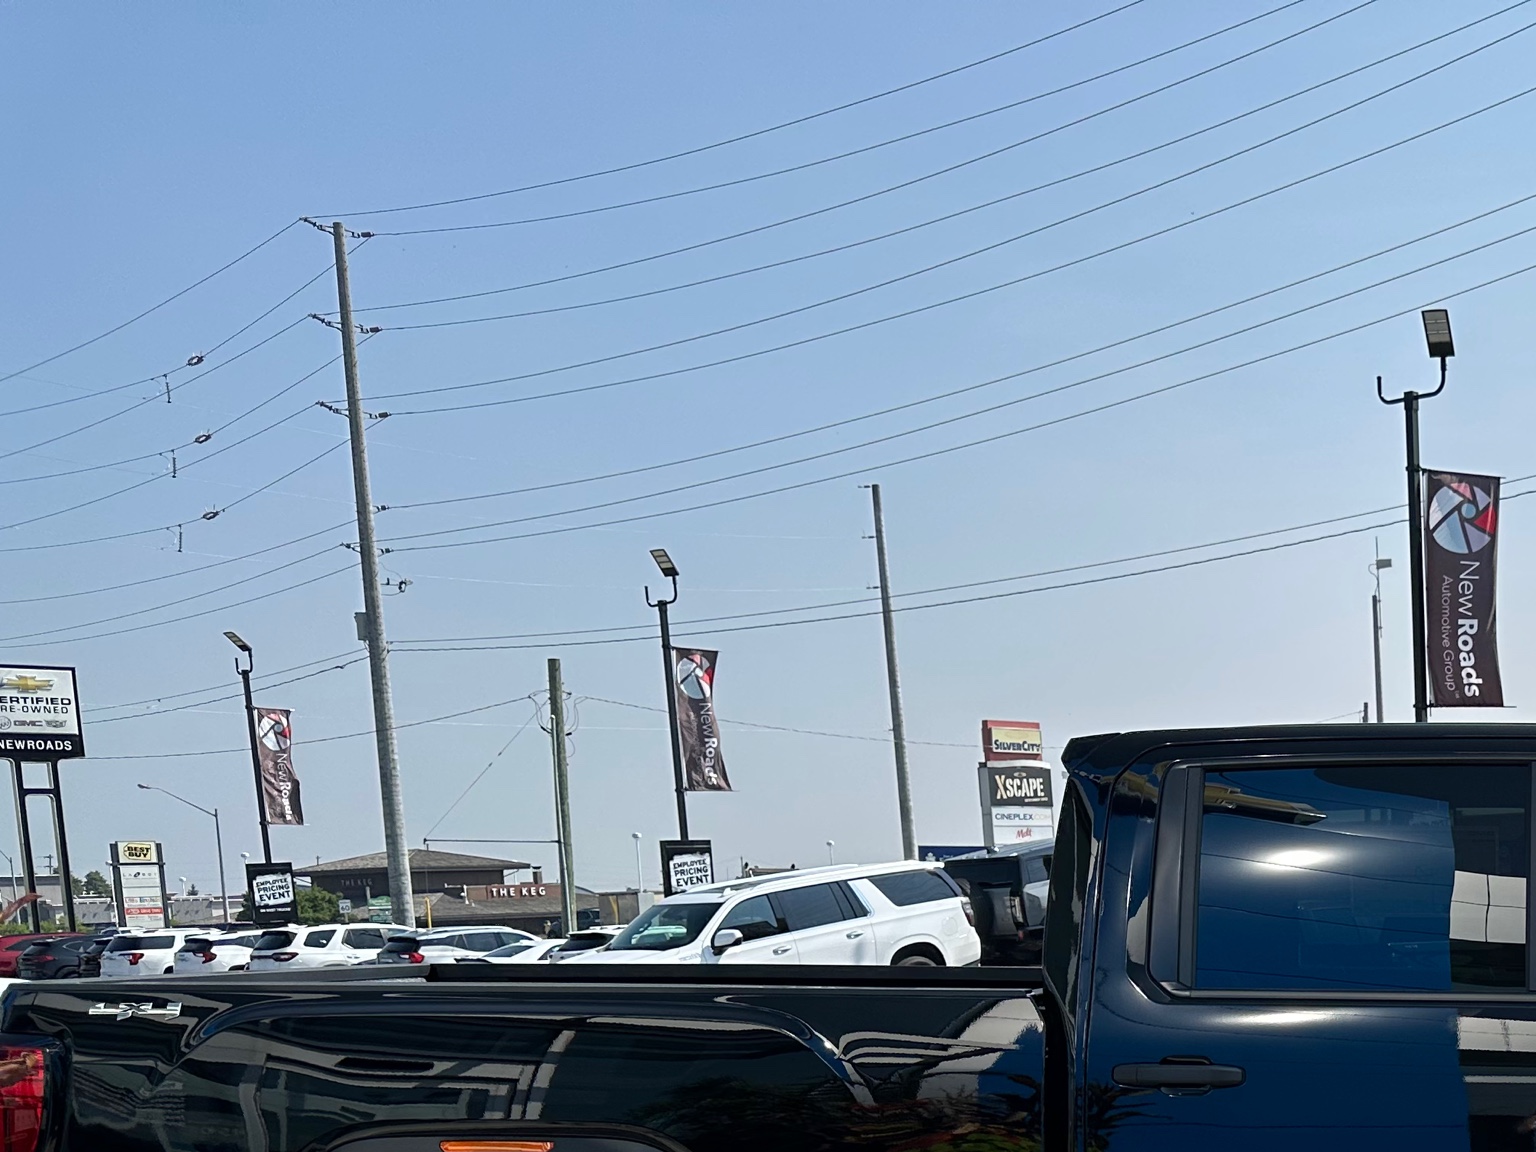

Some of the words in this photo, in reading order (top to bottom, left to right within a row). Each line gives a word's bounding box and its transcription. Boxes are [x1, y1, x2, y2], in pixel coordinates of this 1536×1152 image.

[1441, 575, 1452, 648] Automotive
[1457, 560, 1483, 698] NewRoads
[0, 696, 72, 706] ERTIFIED
[0, 705, 69, 714] RE-OWNED
[699, 702, 718, 786] NewRoads
[673, 859, 707, 869] EMPLOYEE
[674, 866, 708, 877] PRICING
[676, 874, 709, 887] EVENT
[257, 884, 290, 894] PRICING
[491, 887, 516, 897] THE
[521, 887, 546, 896] KEG
[259, 891, 290, 901] EVENT
